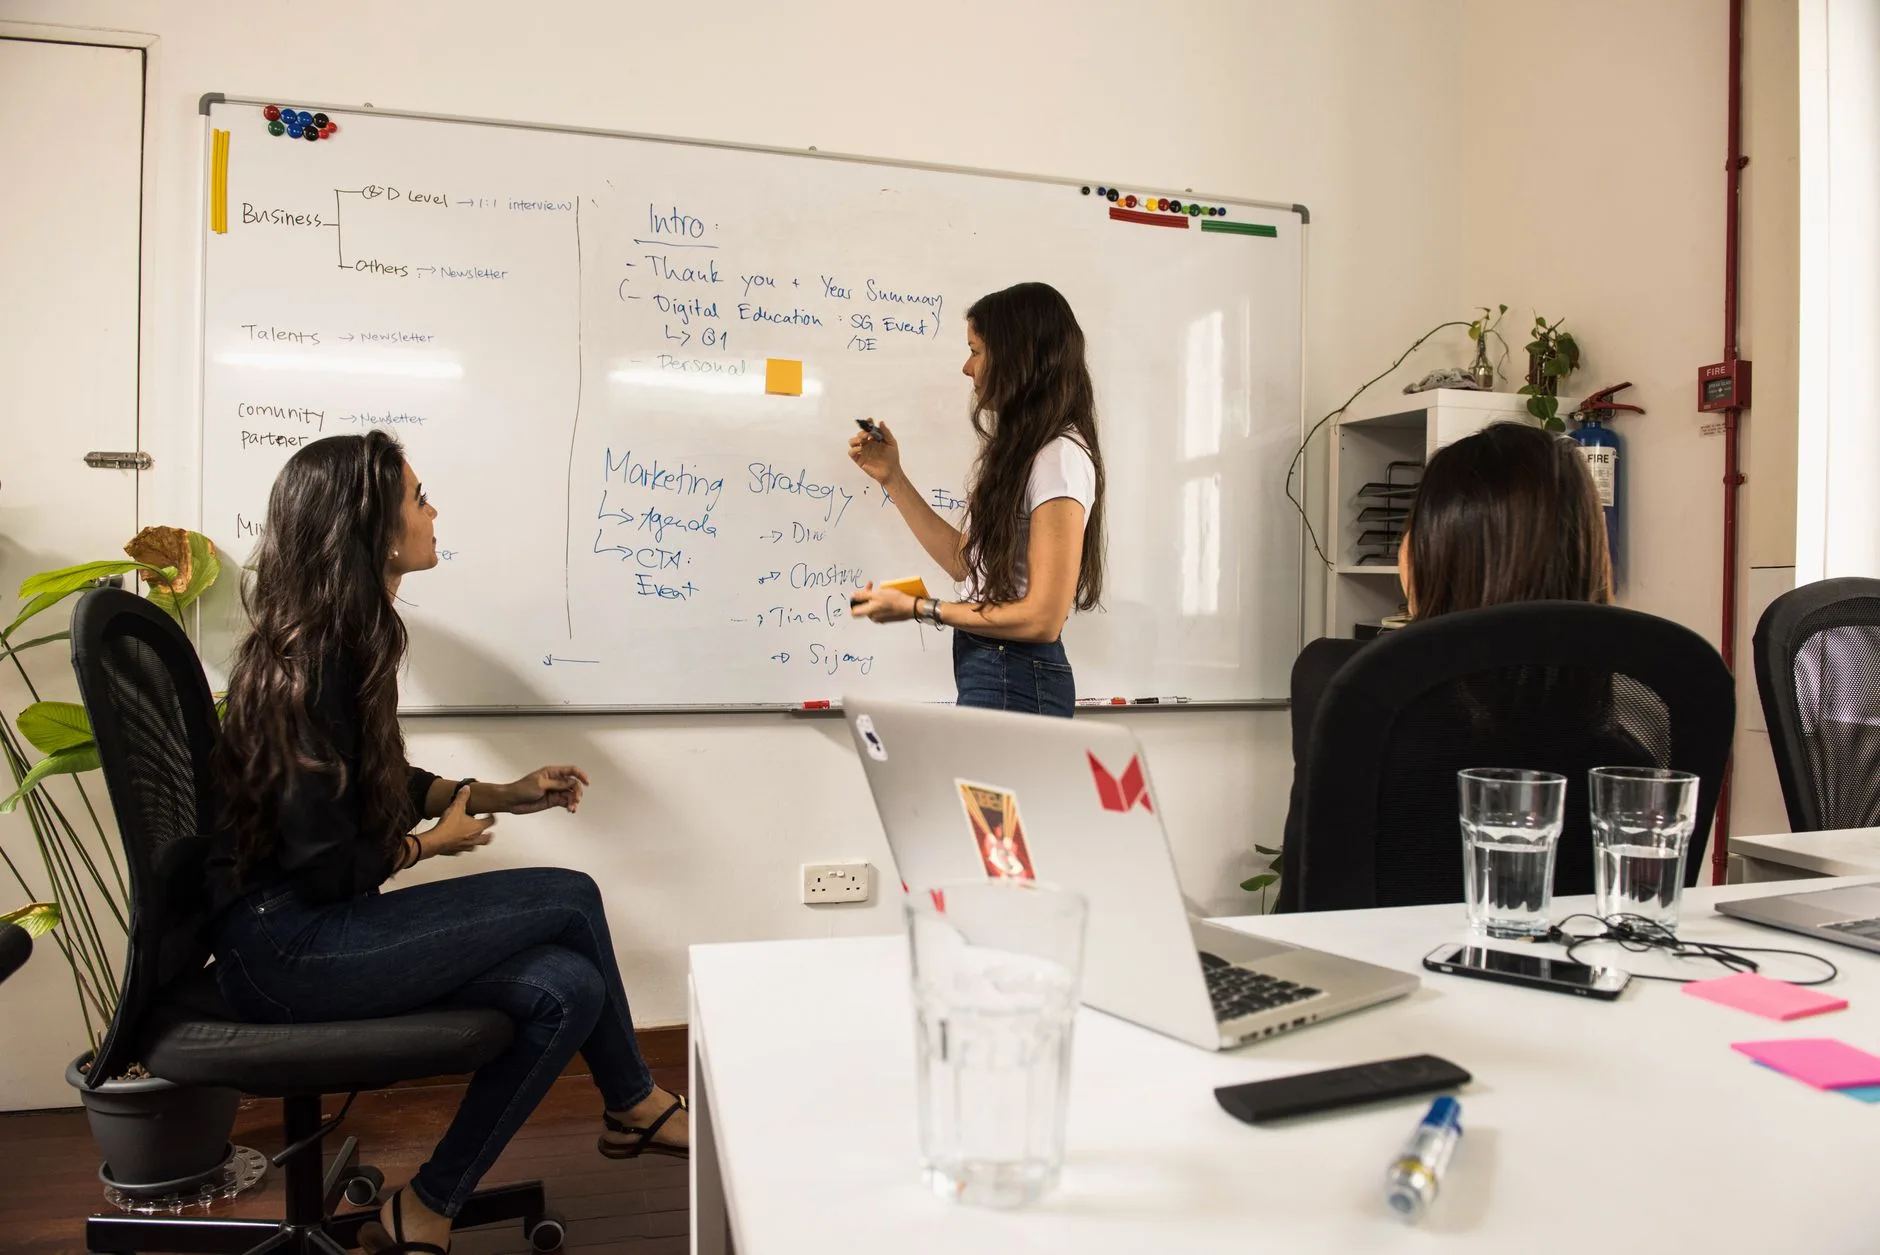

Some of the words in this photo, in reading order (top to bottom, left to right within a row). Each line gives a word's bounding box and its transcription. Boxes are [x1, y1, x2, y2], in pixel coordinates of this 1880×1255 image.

[408, 190, 448, 208] Level
[508, 200, 572, 212] interview
[242, 202, 323, 226] Business
[355, 259, 409, 278] Others
[440, 266, 508, 280] Newsletter
[645, 255, 724, 283] Thank
[742, 274, 776, 297] you
[821, 275, 853, 299] Year
[866, 278, 944, 310] Summary
[653, 294, 721, 325] Digital
[738, 303, 823, 327] Education
[851, 313, 874, 330] SG
[241, 324, 321, 346] Talents
[360, 331, 435, 344] Newsletter
[657, 354, 746, 376] Personal
[1706, 365, 1726, 377] FIRE
[360, 411, 427, 427] Newsletter
[1587, 453, 1610, 464] FIRE
[605, 447, 724, 511] Marketing
[637, 505, 717, 543] Agenda
[635, 573, 701, 600] Event
[769, 606, 820, 627] Tina
